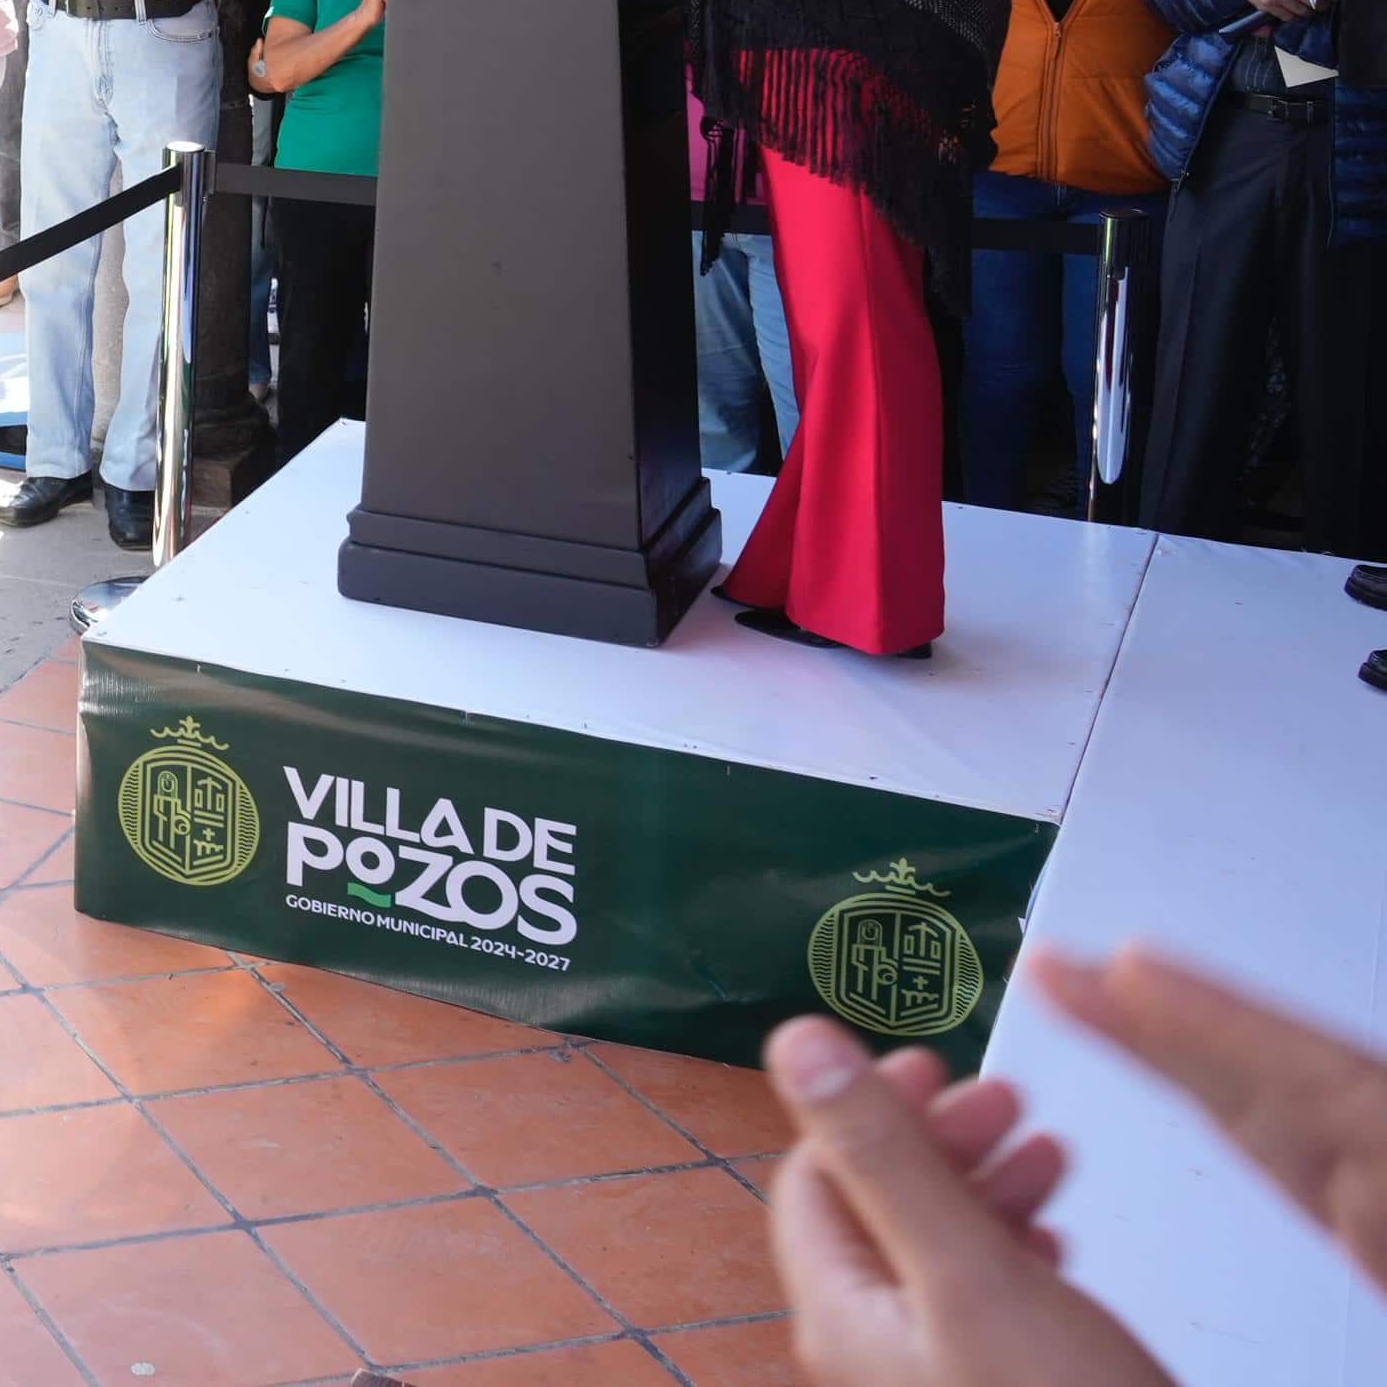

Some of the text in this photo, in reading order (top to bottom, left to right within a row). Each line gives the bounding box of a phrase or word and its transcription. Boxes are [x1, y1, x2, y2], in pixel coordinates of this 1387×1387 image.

[282, 765, 578, 877] VILLA DE
[285, 821, 578, 946] POZOS
[285, 893, 572, 972] GOBIERNO MUNICIPAL 2024-2027
